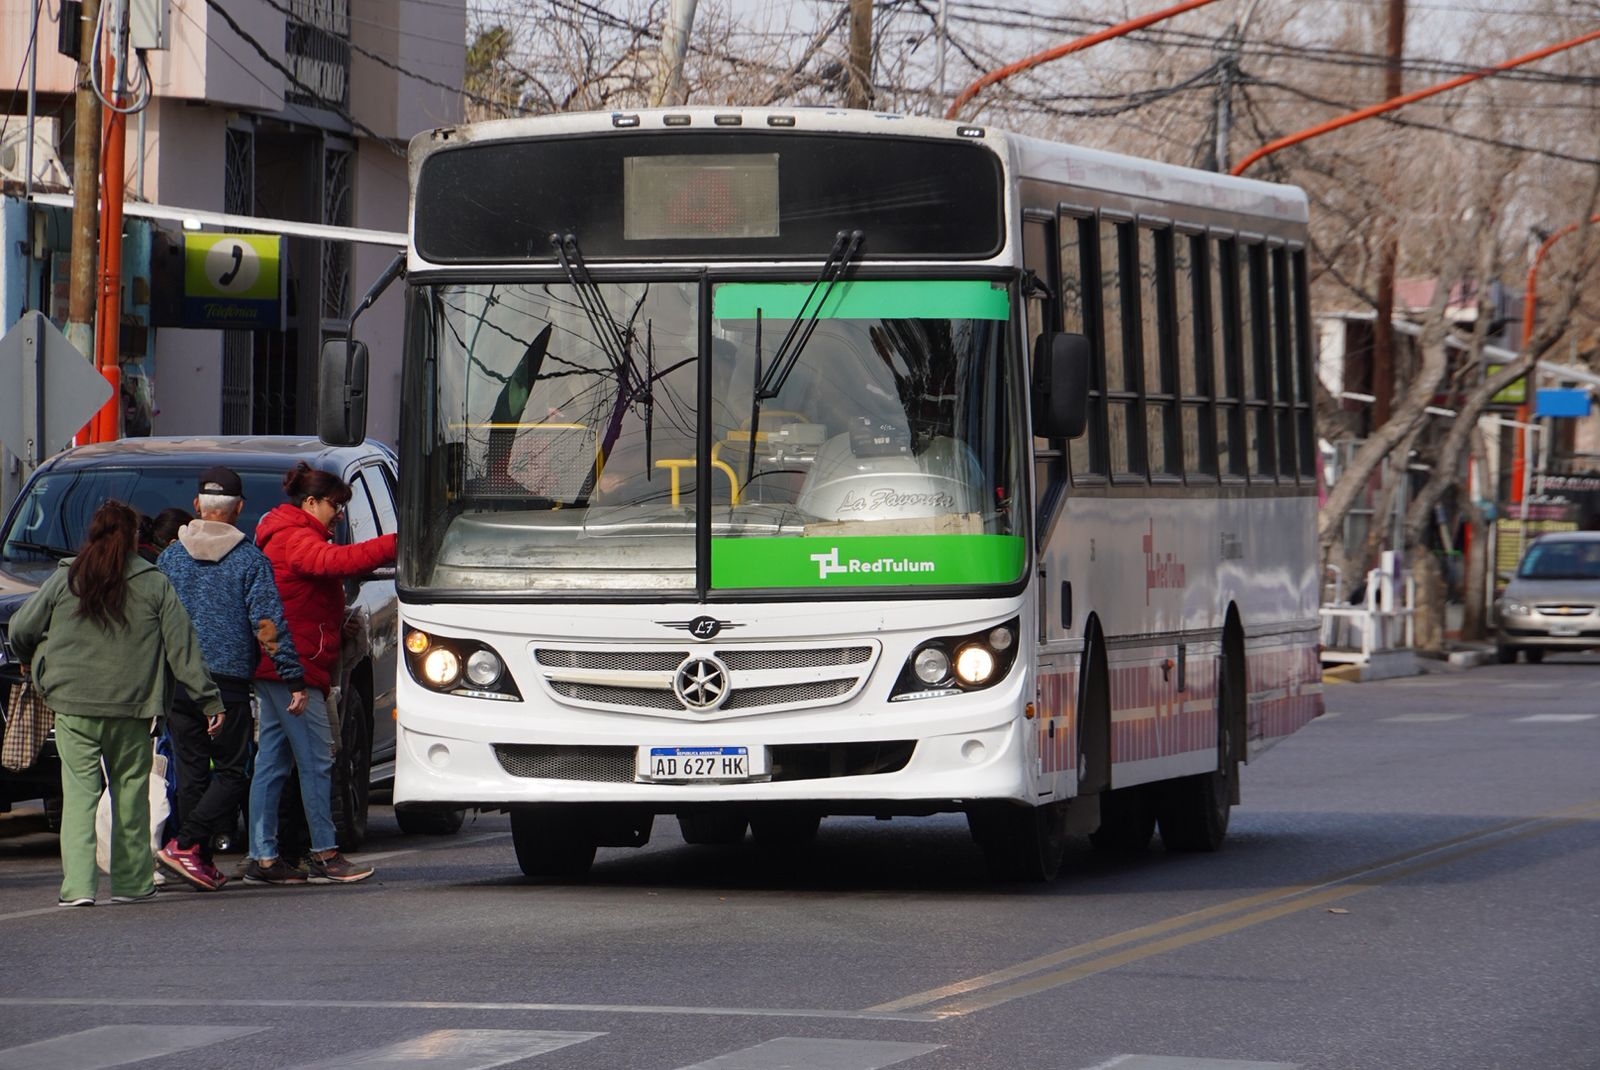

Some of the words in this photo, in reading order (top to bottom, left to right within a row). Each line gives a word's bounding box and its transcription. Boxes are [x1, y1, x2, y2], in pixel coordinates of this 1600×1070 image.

[836, 489, 867, 513] La
[848, 557, 936, 574] RedTulum
[656, 758, 677, 775] AD
[683, 757, 716, 775] 627
[722, 757, 743, 775] HK
